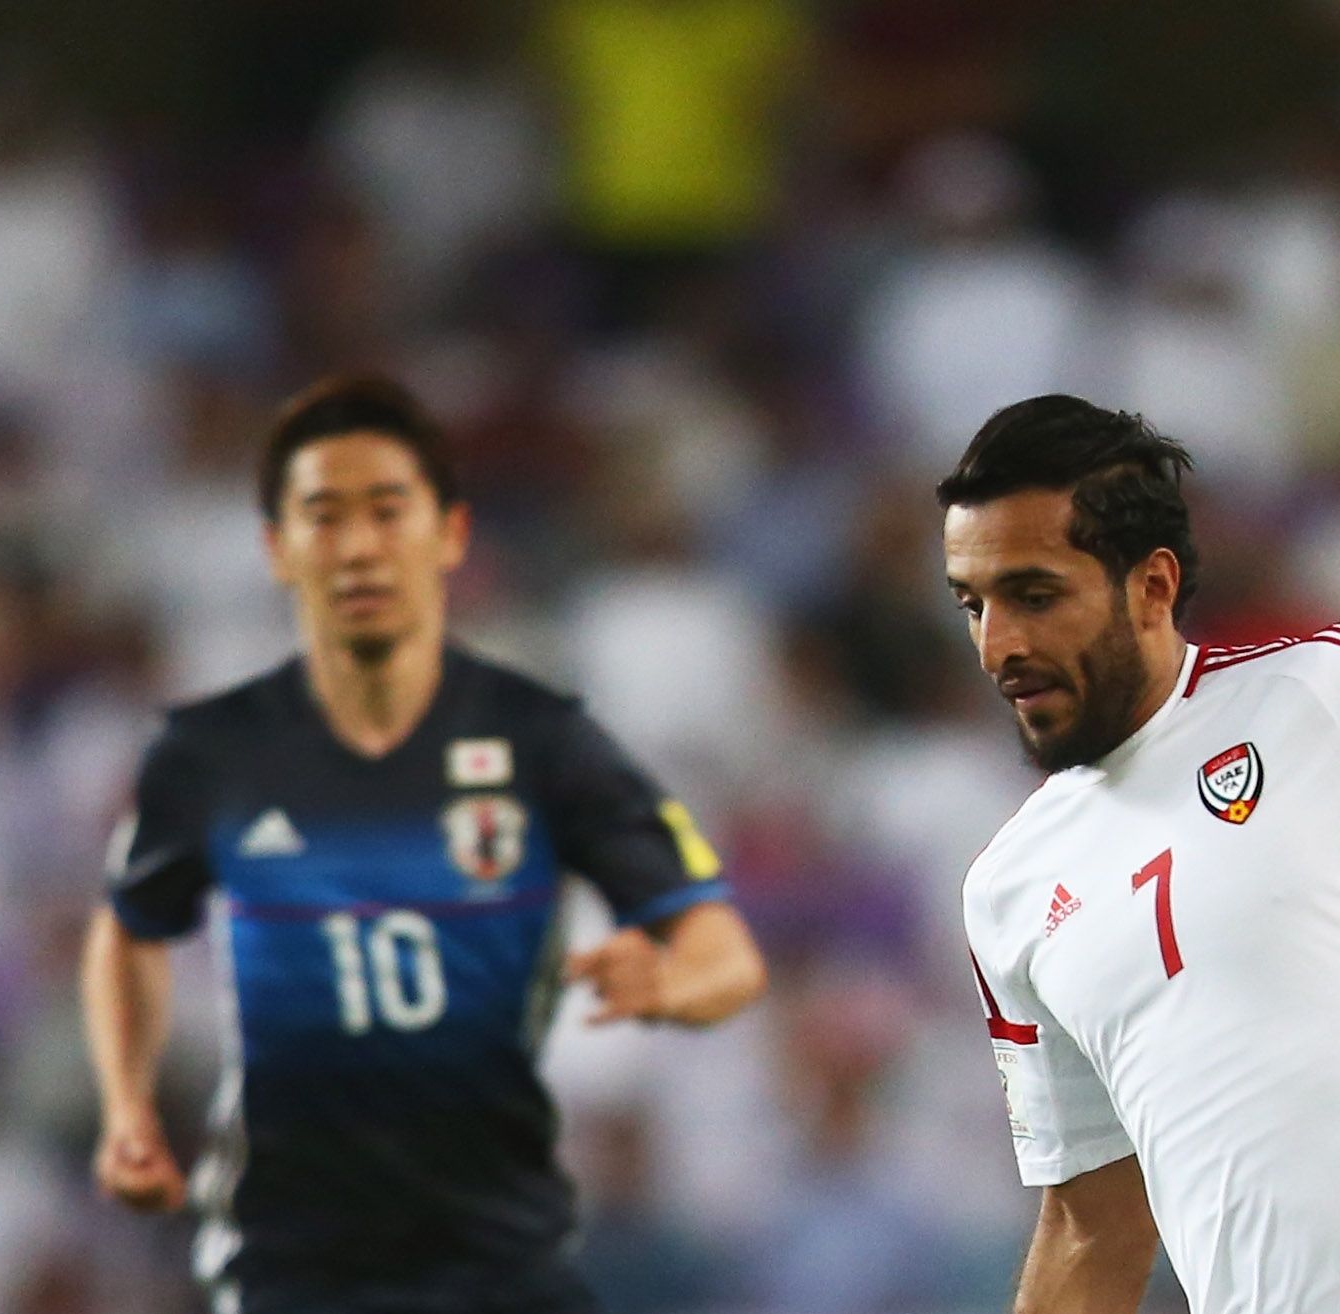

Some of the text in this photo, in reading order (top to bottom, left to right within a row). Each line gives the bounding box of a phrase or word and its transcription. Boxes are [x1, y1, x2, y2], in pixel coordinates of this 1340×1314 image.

[1214, 765, 1244, 786] UAE
[320, 909, 448, 1035] 10
[1132, 847, 1184, 980] 7
